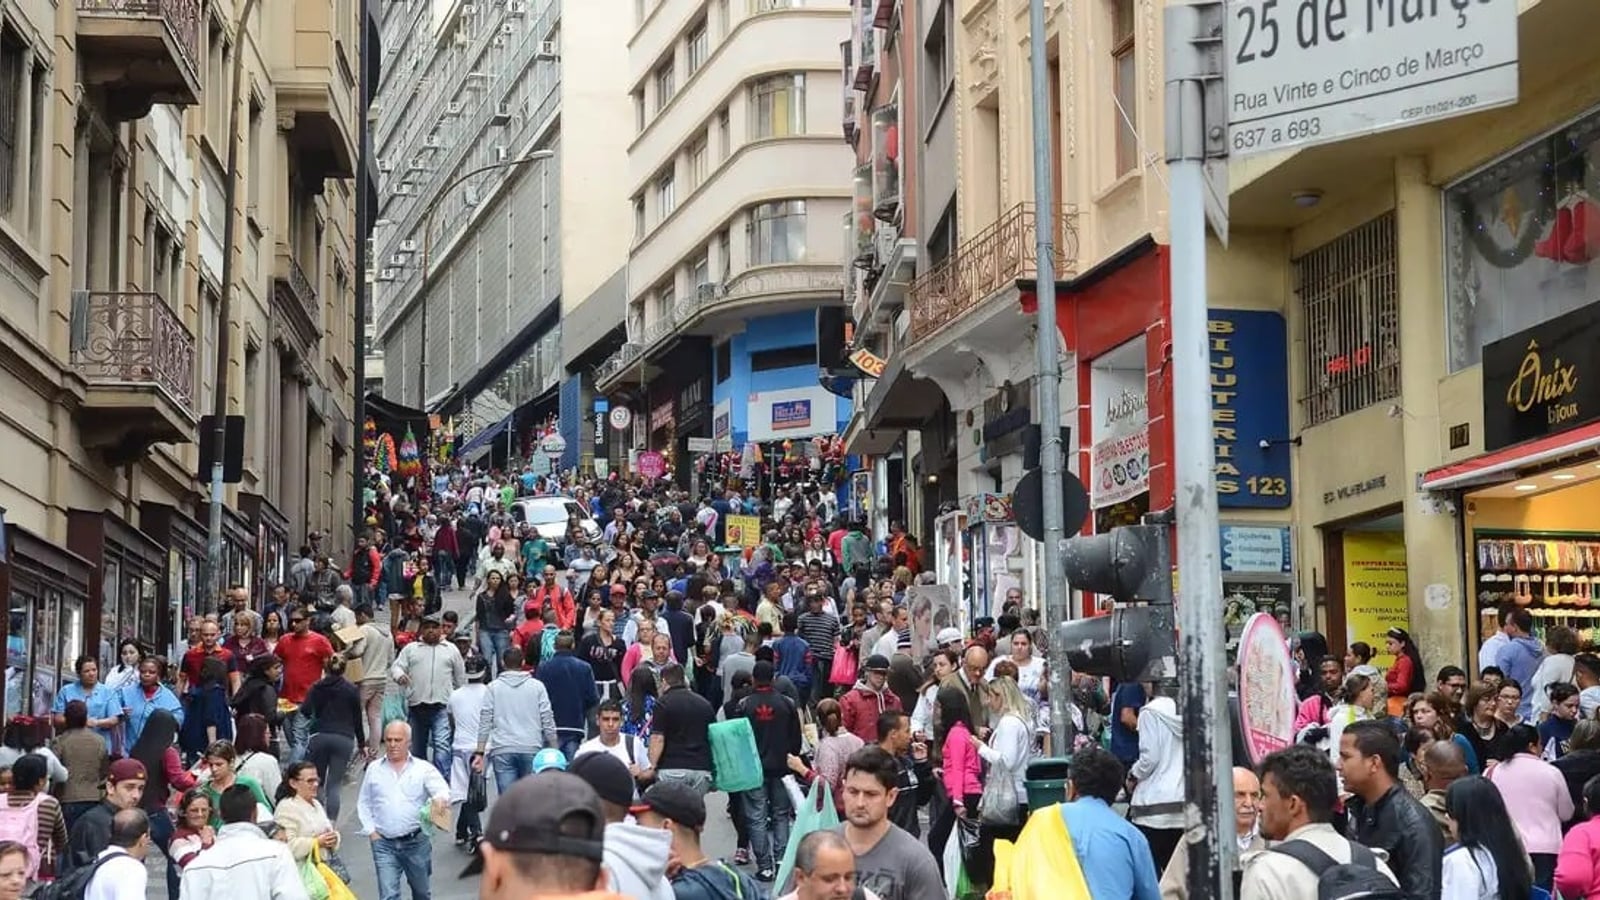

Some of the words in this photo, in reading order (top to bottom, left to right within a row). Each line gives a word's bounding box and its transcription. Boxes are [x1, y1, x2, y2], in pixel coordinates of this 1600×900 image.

[1236, 0, 1279, 65] 25
[1297, 0, 1347, 49] de
[1233, 93, 1268, 112] Rua
[1274, 82, 1318, 104] Vinte
[1323, 79, 1334, 94] e
[1339, 69, 1391, 90] Cinco
[1396, 57, 1419, 75] de
[1426, 42, 1484, 70] Março
[1401, 106, 1423, 120] CEP
[1233, 129, 1266, 150] 637
[1271, 129, 1281, 143] a
[1287, 117, 1321, 140] 693
[855, 350, 886, 375] 103
[1507, 339, 1578, 413] Ônix
[1207, 320, 1240, 494] BIJUTERIAS
[1548, 402, 1579, 425] bijoux
[1246, 476, 1287, 496] 123
